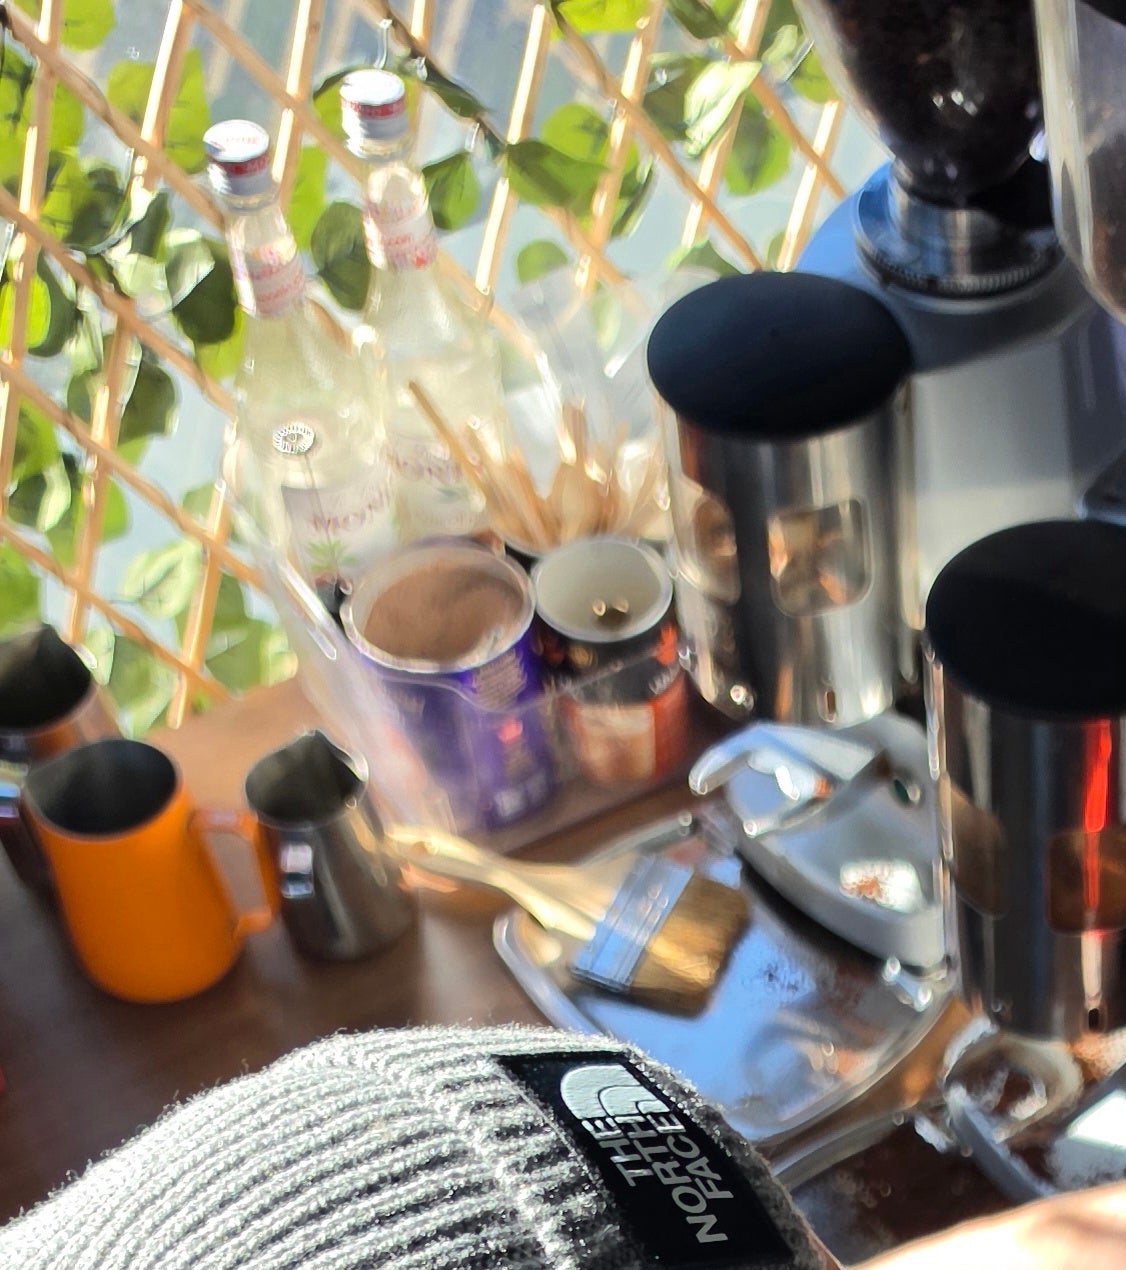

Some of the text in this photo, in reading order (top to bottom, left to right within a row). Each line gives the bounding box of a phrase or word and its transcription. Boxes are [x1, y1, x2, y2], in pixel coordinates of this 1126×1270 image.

[582, 1117, 654, 1187] THE
[613, 1115, 729, 1244] NORTH
[650, 1113, 734, 1199] FACE
